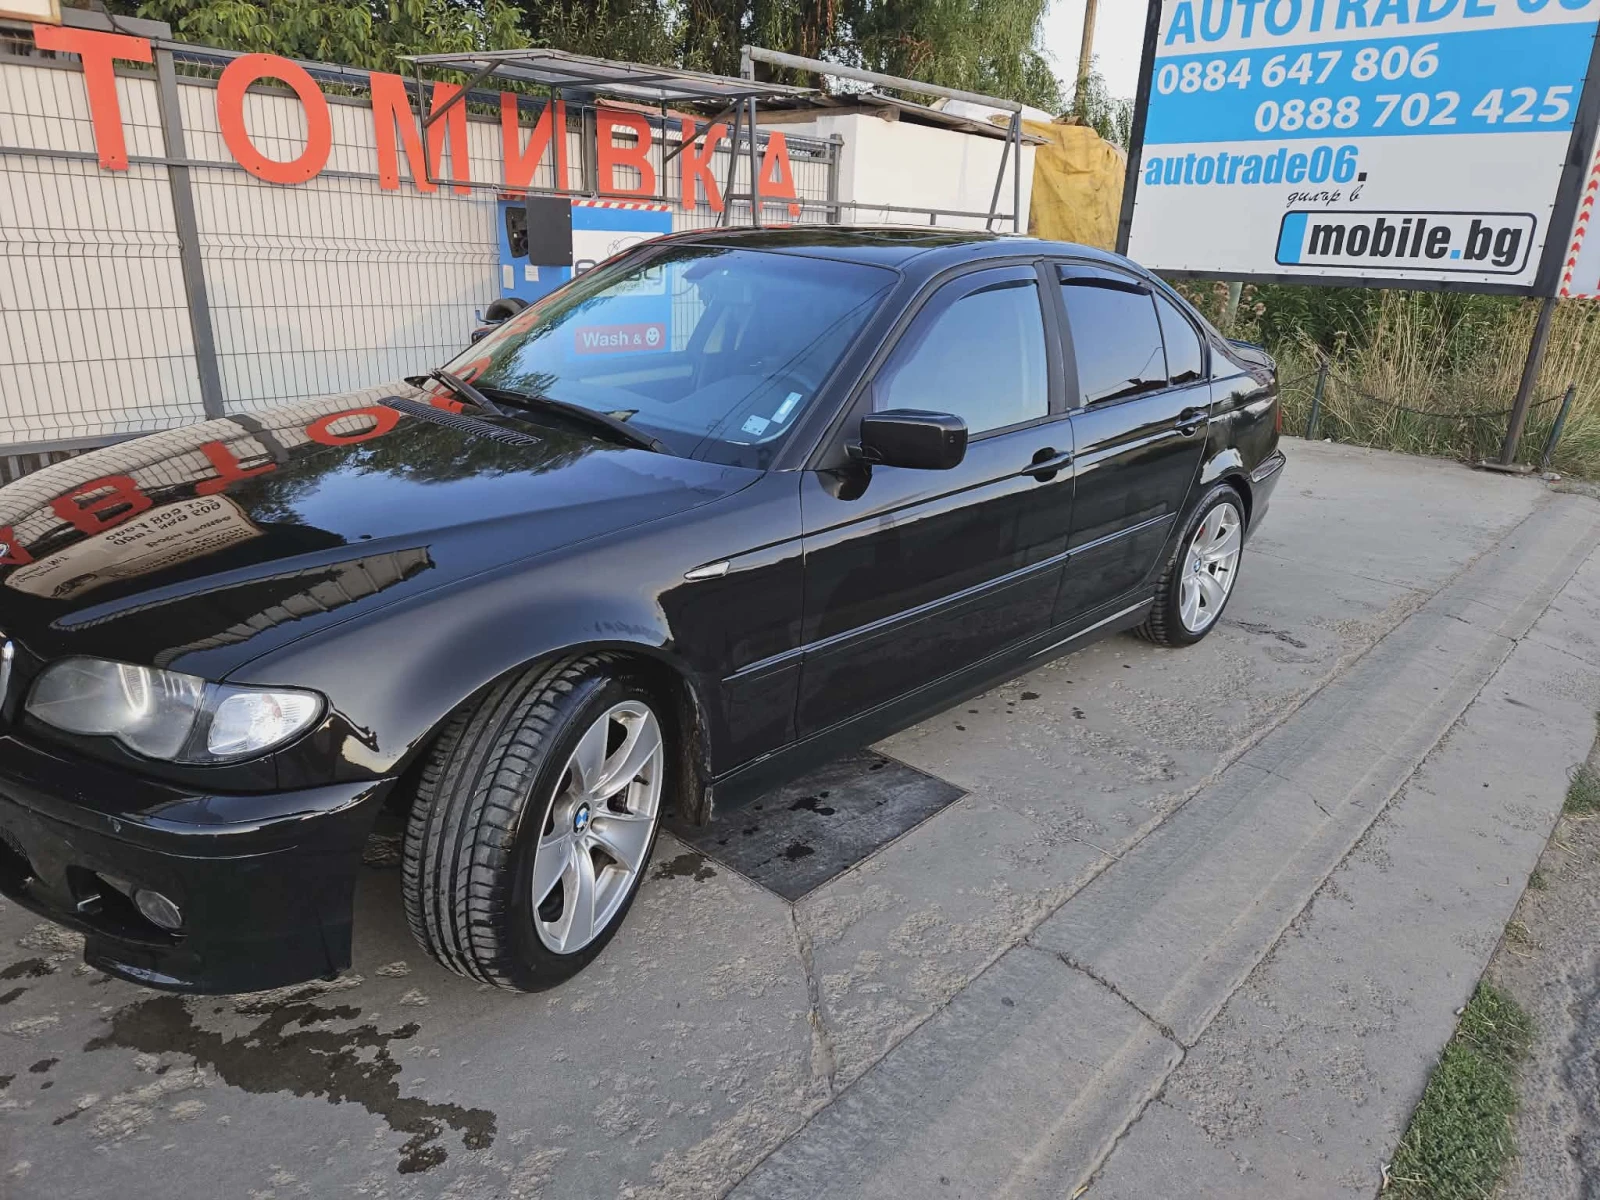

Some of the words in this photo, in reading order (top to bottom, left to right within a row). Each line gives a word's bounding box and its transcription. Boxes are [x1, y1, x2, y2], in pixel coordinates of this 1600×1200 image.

[1156, 58, 1251, 95] 0884
[1262, 50, 1342, 88] 647
[1351, 42, 1439, 82] 806
[1254, 96, 1361, 133] 0888
[1373, 90, 1461, 128] 702
[1472, 85, 1573, 123] 425
[1308, 217, 1523, 267] mobile.bg
[583, 331, 628, 348] Wash
[633, 333, 642, 345] &
